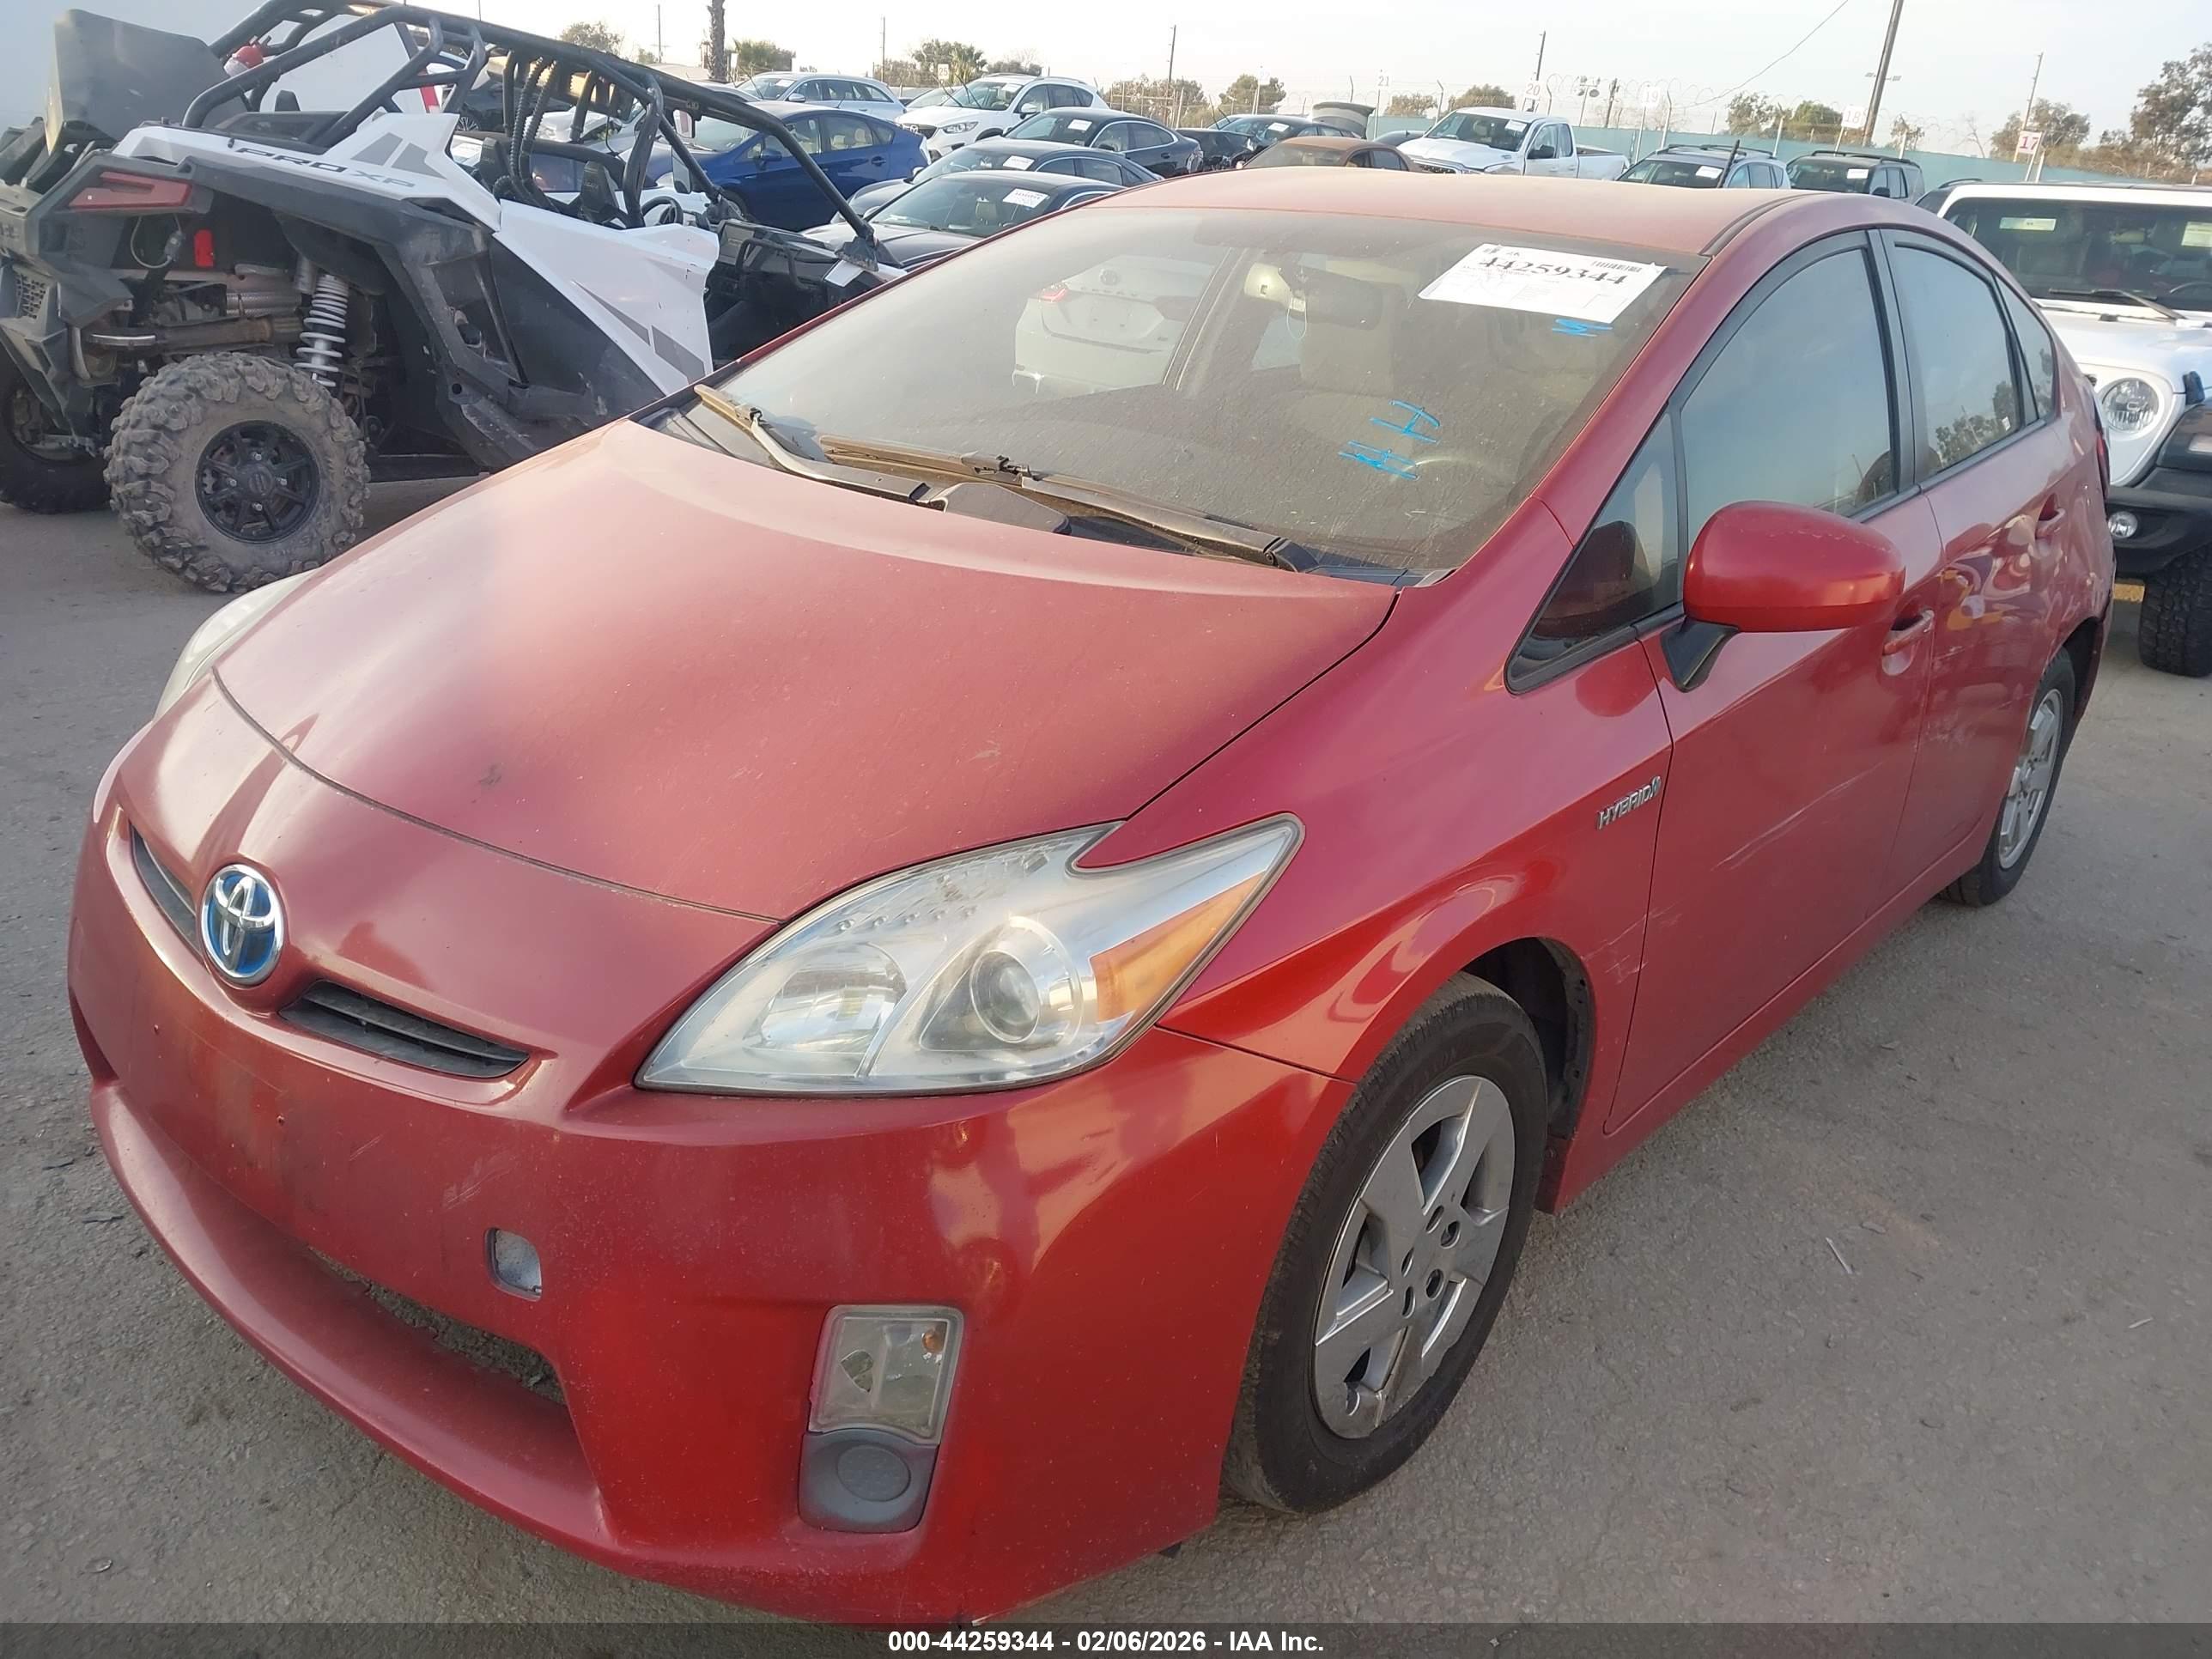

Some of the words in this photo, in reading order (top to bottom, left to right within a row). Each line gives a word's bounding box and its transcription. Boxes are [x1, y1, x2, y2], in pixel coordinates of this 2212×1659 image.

[939, 68, 948, 76] 25
[1378, 76, 1389, 86] 21
[1526, 83, 1540, 95] 20
[1646, 91, 1658, 102] 19
[1844, 111, 1862, 123] 18
[2019, 136, 2039, 150] 17
[236, 147, 347, 173] PRO
[350, 170, 415, 188] XP
[1479, 257, 1628, 284] 44259344
[1596, 783, 1653, 830] HYBRID
